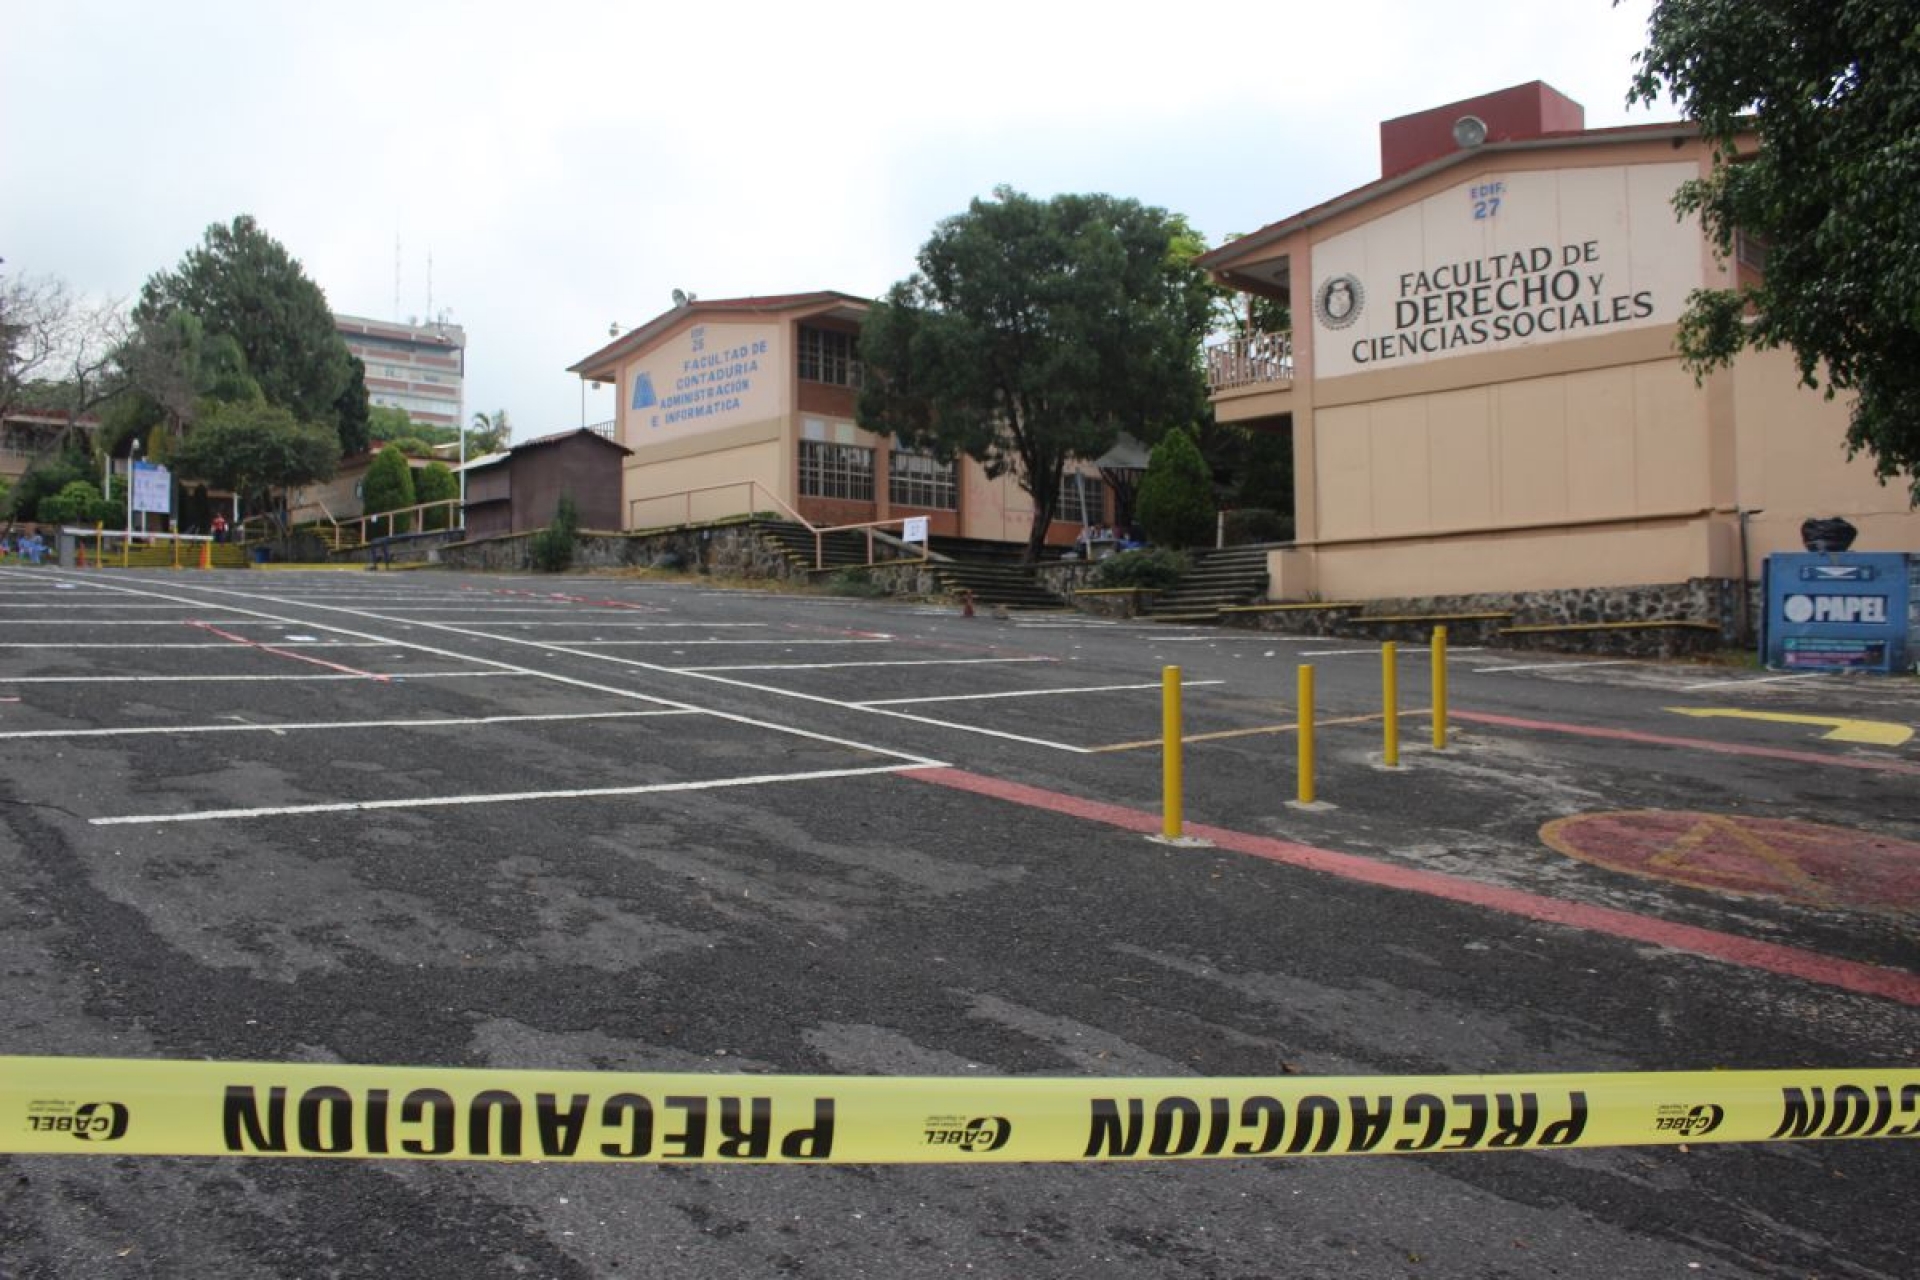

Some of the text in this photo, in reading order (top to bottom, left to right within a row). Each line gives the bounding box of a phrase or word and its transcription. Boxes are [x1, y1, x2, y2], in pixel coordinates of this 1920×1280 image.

[1474, 198, 1500, 219] 27
[1400, 240, 1599, 297] FACULTAD DE
[1352, 291, 1654, 363] CIENCIAS SOCIALES
[1395, 269, 1604, 330] DERECHO Y
[684, 340, 768, 372] FACULTAD DE
[652, 415, 660, 428] E
[1815, 596, 1886, 622] PAPEL
[223, 1085, 835, 1158] PRECAUCION
[1084, 1091, 1588, 1158] PRECAUCION
